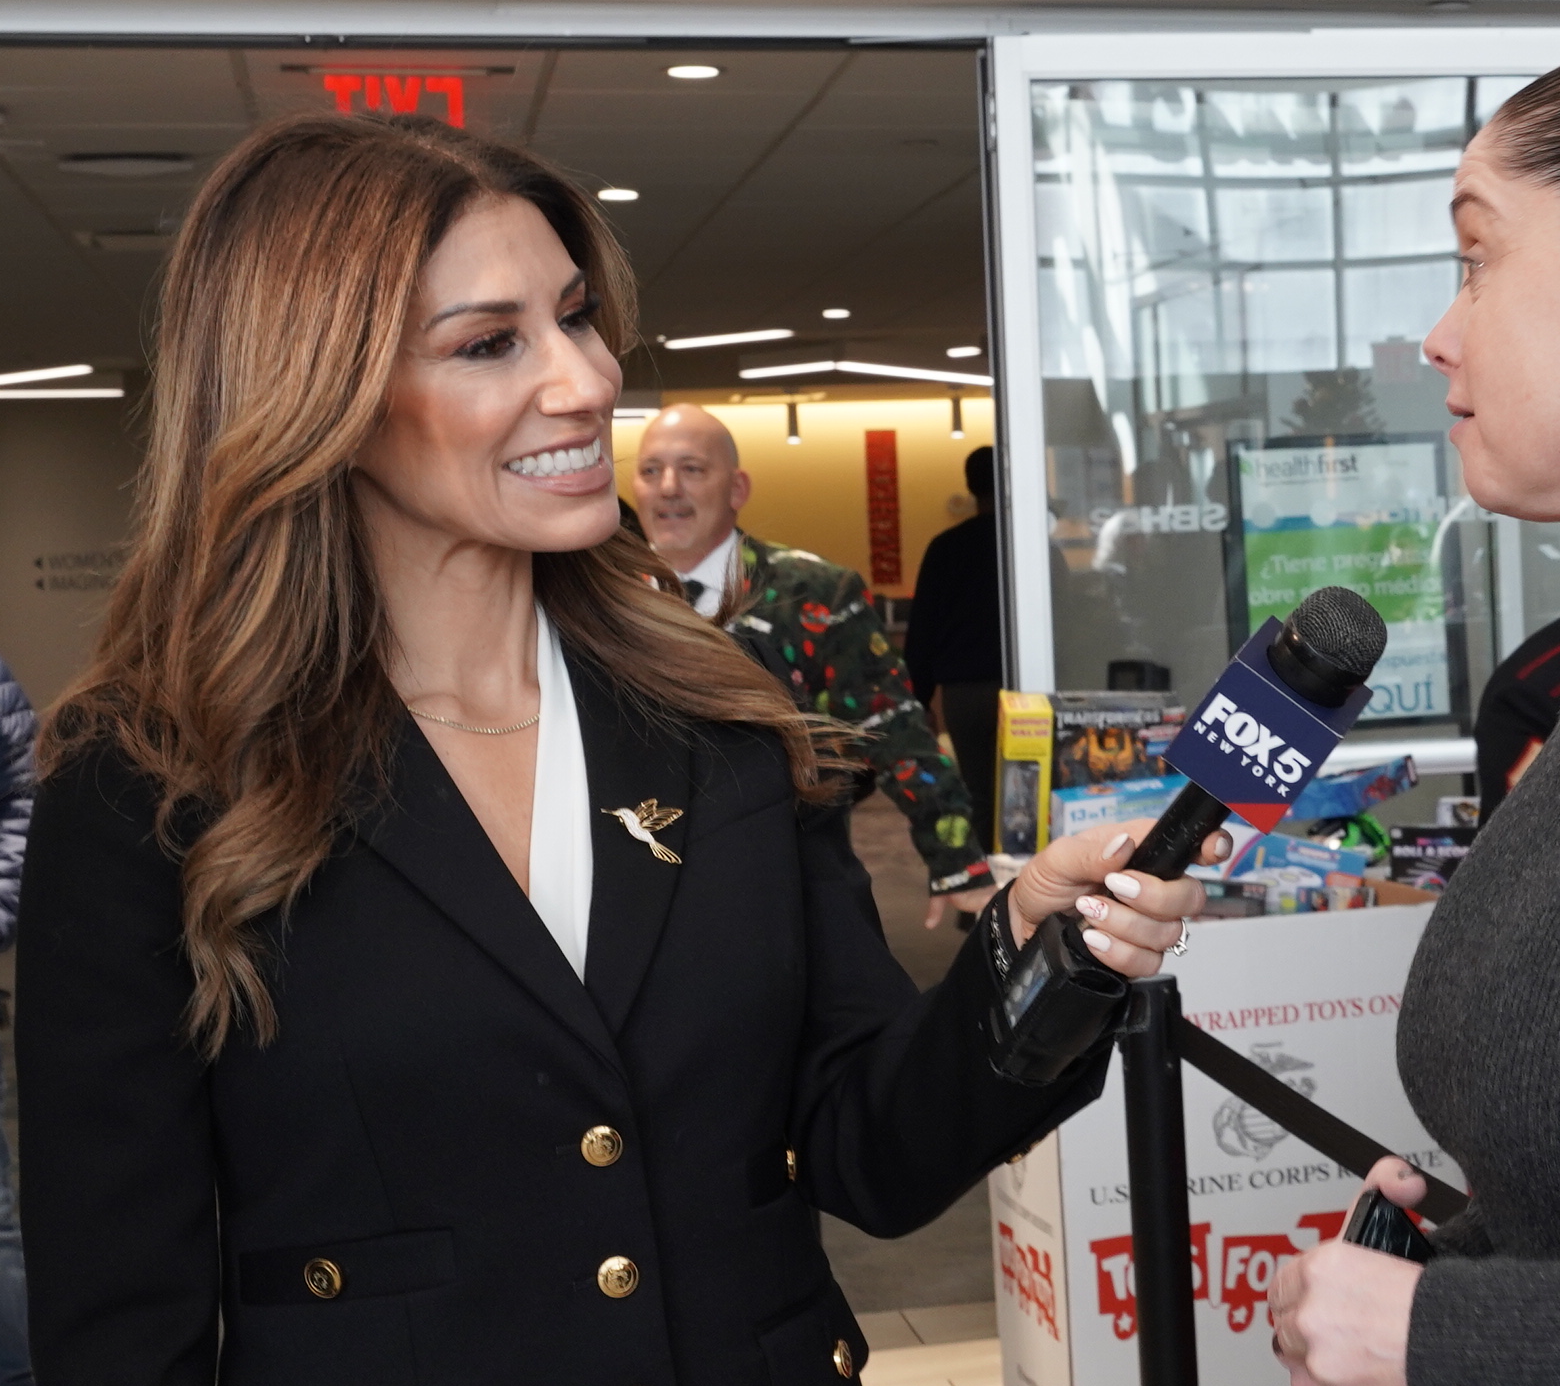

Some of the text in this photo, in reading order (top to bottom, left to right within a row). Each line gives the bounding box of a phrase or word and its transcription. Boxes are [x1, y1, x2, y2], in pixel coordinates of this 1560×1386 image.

[1248, 585, 1295, 606] obre
[1366, 673, 1434, 716] QUÍ
[1193, 721, 1235, 754] NEW
[1241, 755, 1290, 797] YORK
[1186, 993, 1404, 1030] WRAPPED TOYS ON
[1090, 1183, 1129, 1206] U.S
[1188, 1173, 1243, 1196] RINE
[1248, 1163, 1330, 1190] CORPS
